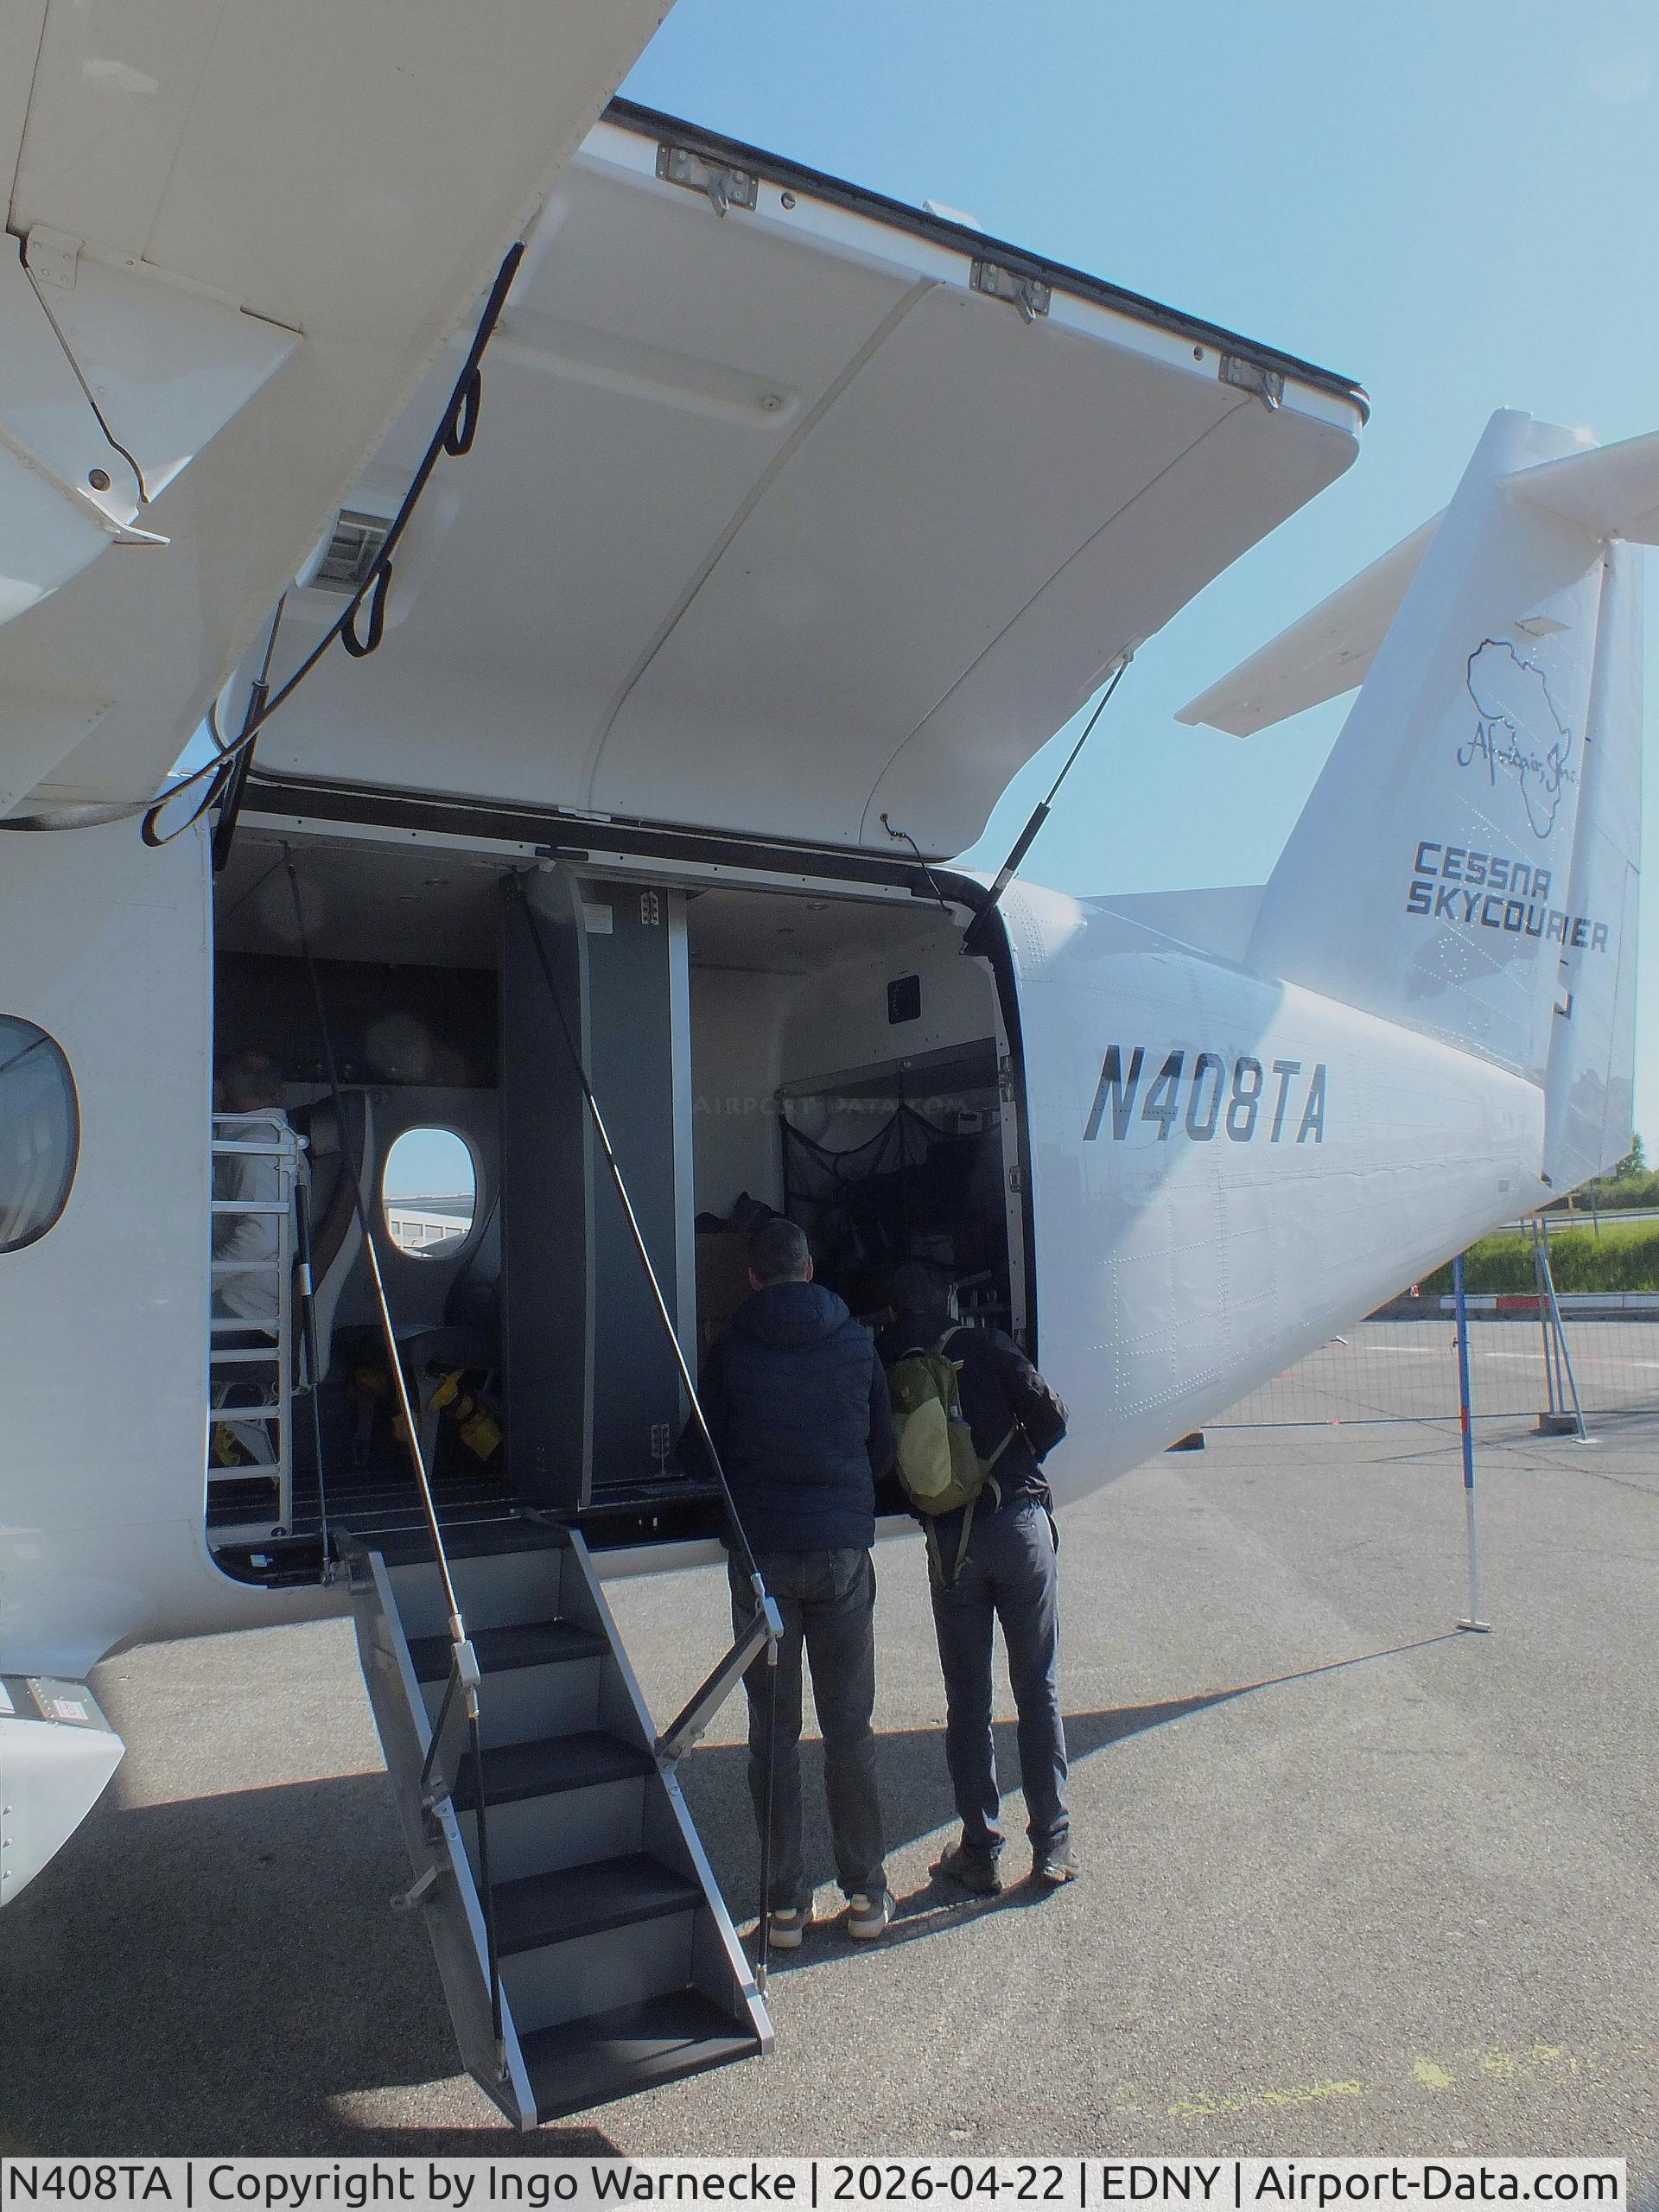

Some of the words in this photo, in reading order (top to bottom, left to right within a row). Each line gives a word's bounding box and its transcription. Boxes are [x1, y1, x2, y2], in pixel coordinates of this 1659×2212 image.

[1414, 841, 1552, 900] CESSNA
[1406, 880, 1608, 953] SKYCOURIER
[1082, 1044, 1327, 1143] N408TA
